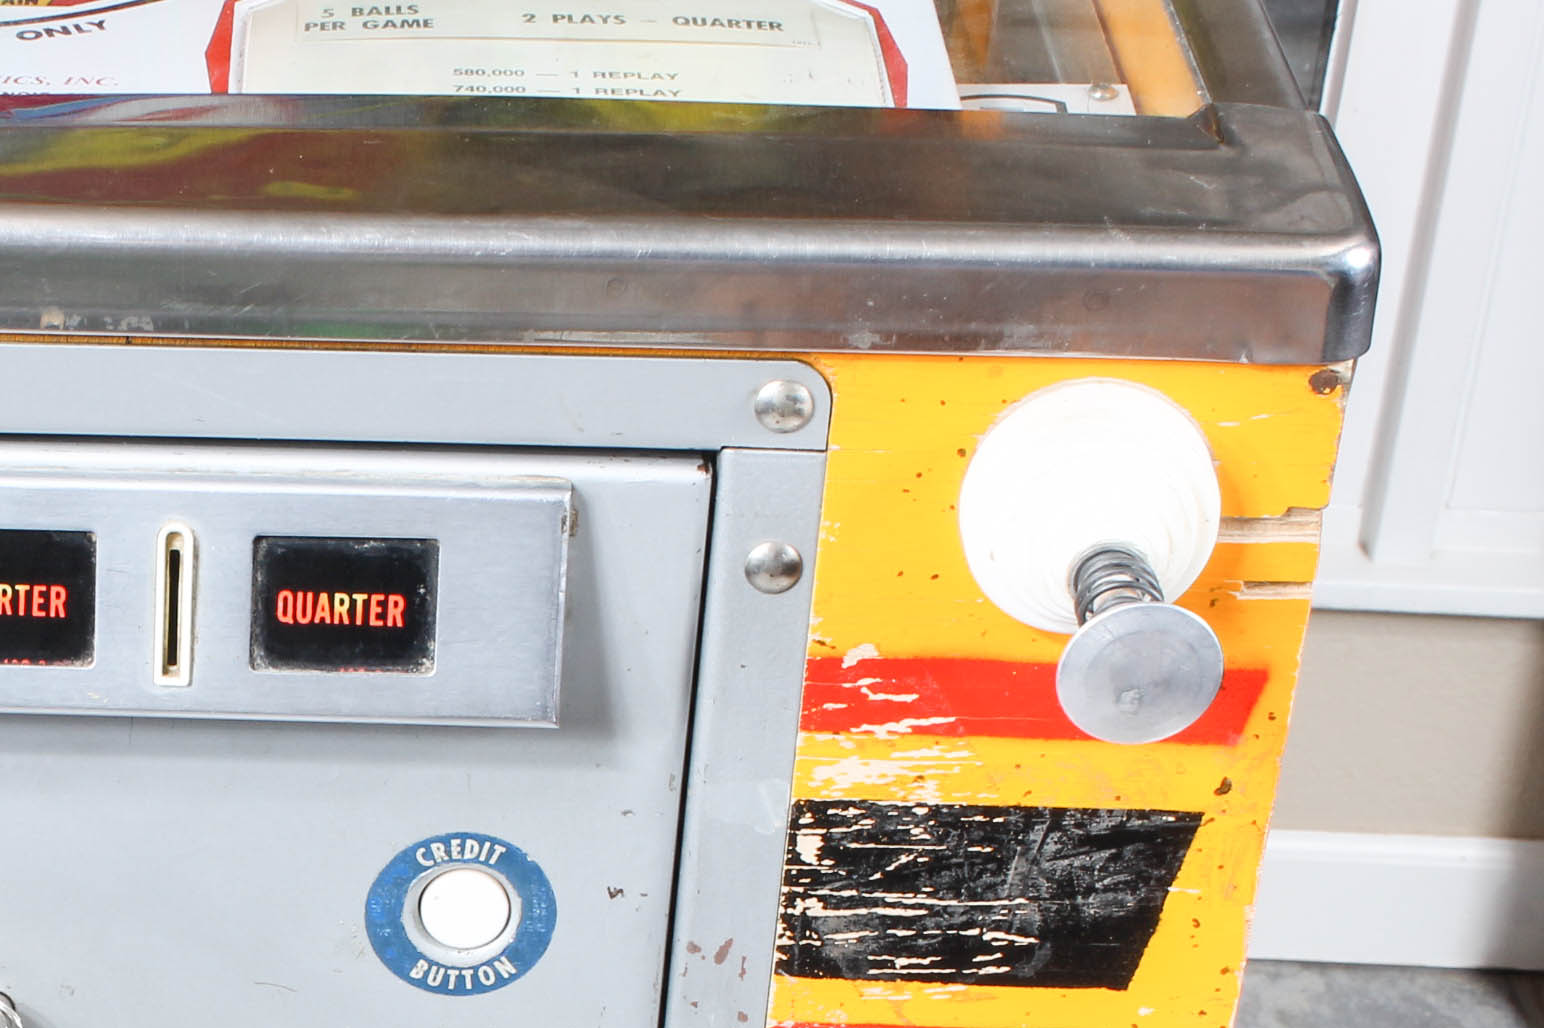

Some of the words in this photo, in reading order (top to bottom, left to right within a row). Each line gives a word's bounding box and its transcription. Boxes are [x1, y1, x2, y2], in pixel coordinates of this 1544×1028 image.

[320, 8, 334, 19] 5
[350, 5, 419, 17] BALLS
[15, 19, 107, 41] ONLY
[303, 20, 347, 32] PER
[361, 18, 435, 30] GAME
[522, 13, 537, 23] 2
[551, 14, 626, 25] PLAYS
[672, 16, 784, 32] QUARTER
[63, 75, 119, 87] INC.
[592, 71, 680, 81] REPLAY
[594, 87, 684, 98] REPLAY
[274, 589, 406, 628] QUARTER
[415, 838, 508, 867] CREDIT
[409, 956, 518, 990] BUTTON
